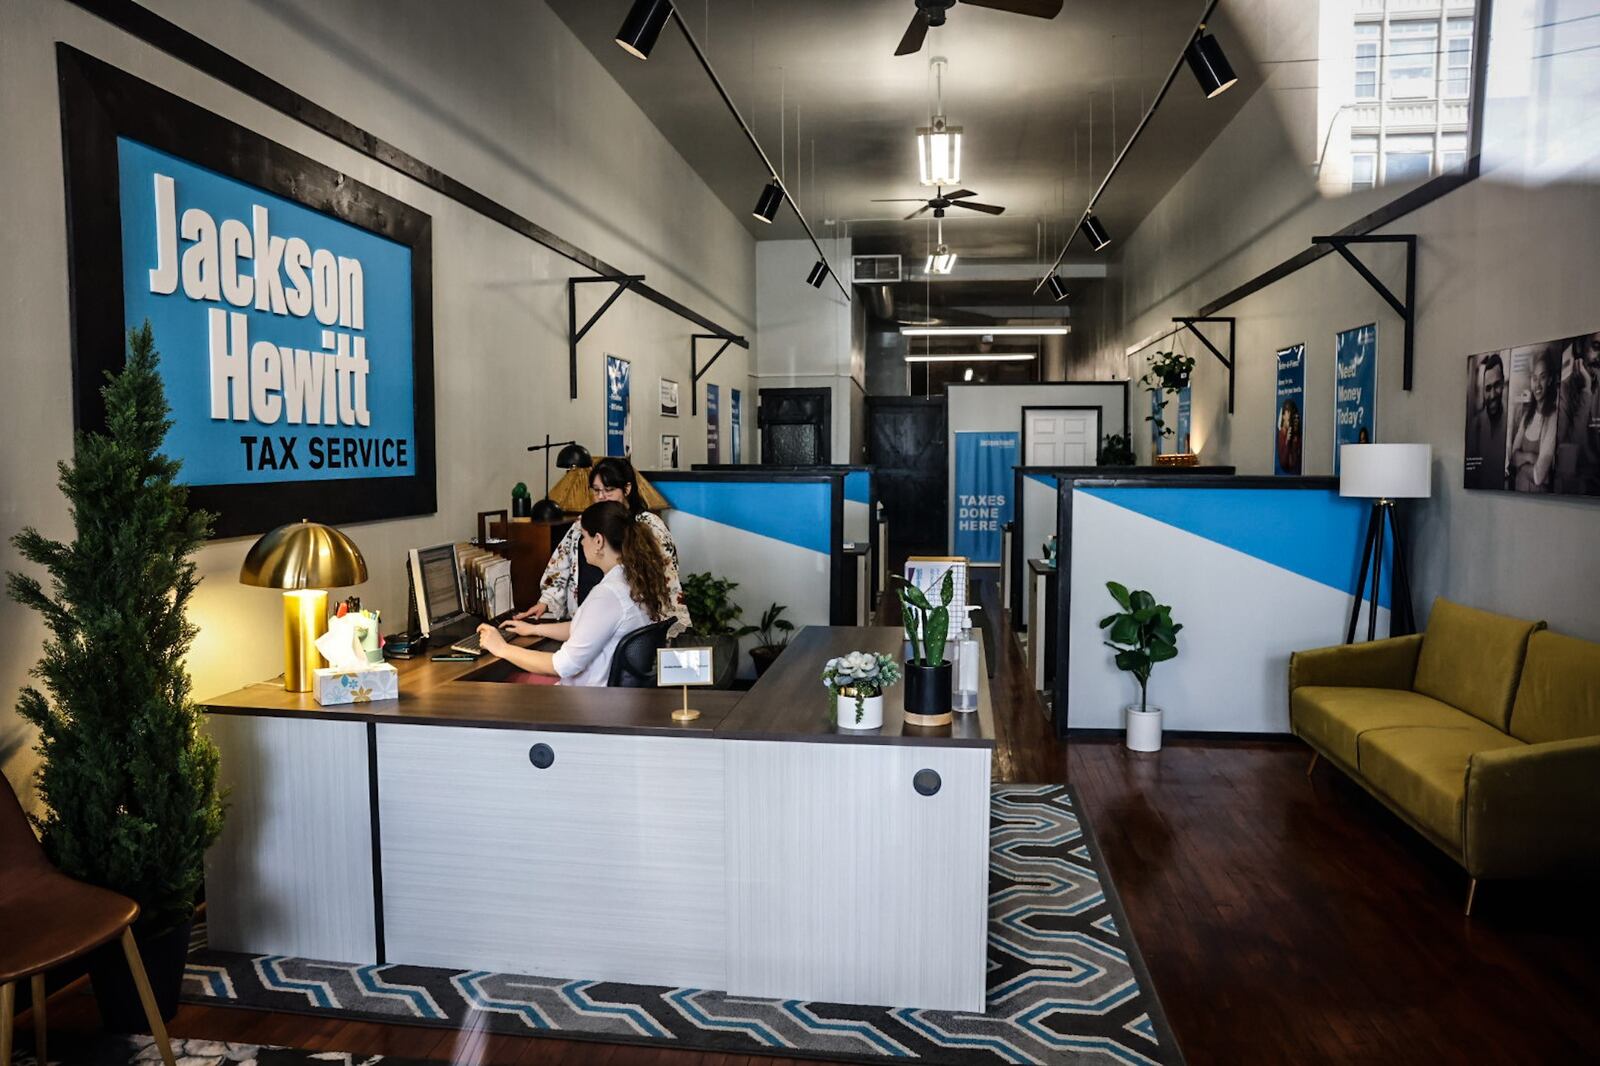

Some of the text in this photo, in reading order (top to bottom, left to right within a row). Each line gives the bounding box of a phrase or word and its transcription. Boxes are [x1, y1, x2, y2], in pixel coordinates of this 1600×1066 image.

[149, 173, 364, 330] Jackson
[208, 307, 370, 427] Hewitt
[1338, 362, 1357, 379] Need
[1338, 385, 1362, 405] Money
[1337, 406, 1364, 429] Today?
[240, 435, 408, 471] TAX SERVICE
[959, 495, 1006, 506] TAXES
[959, 508, 999, 519] DONE
[959, 520, 998, 531] HERE
